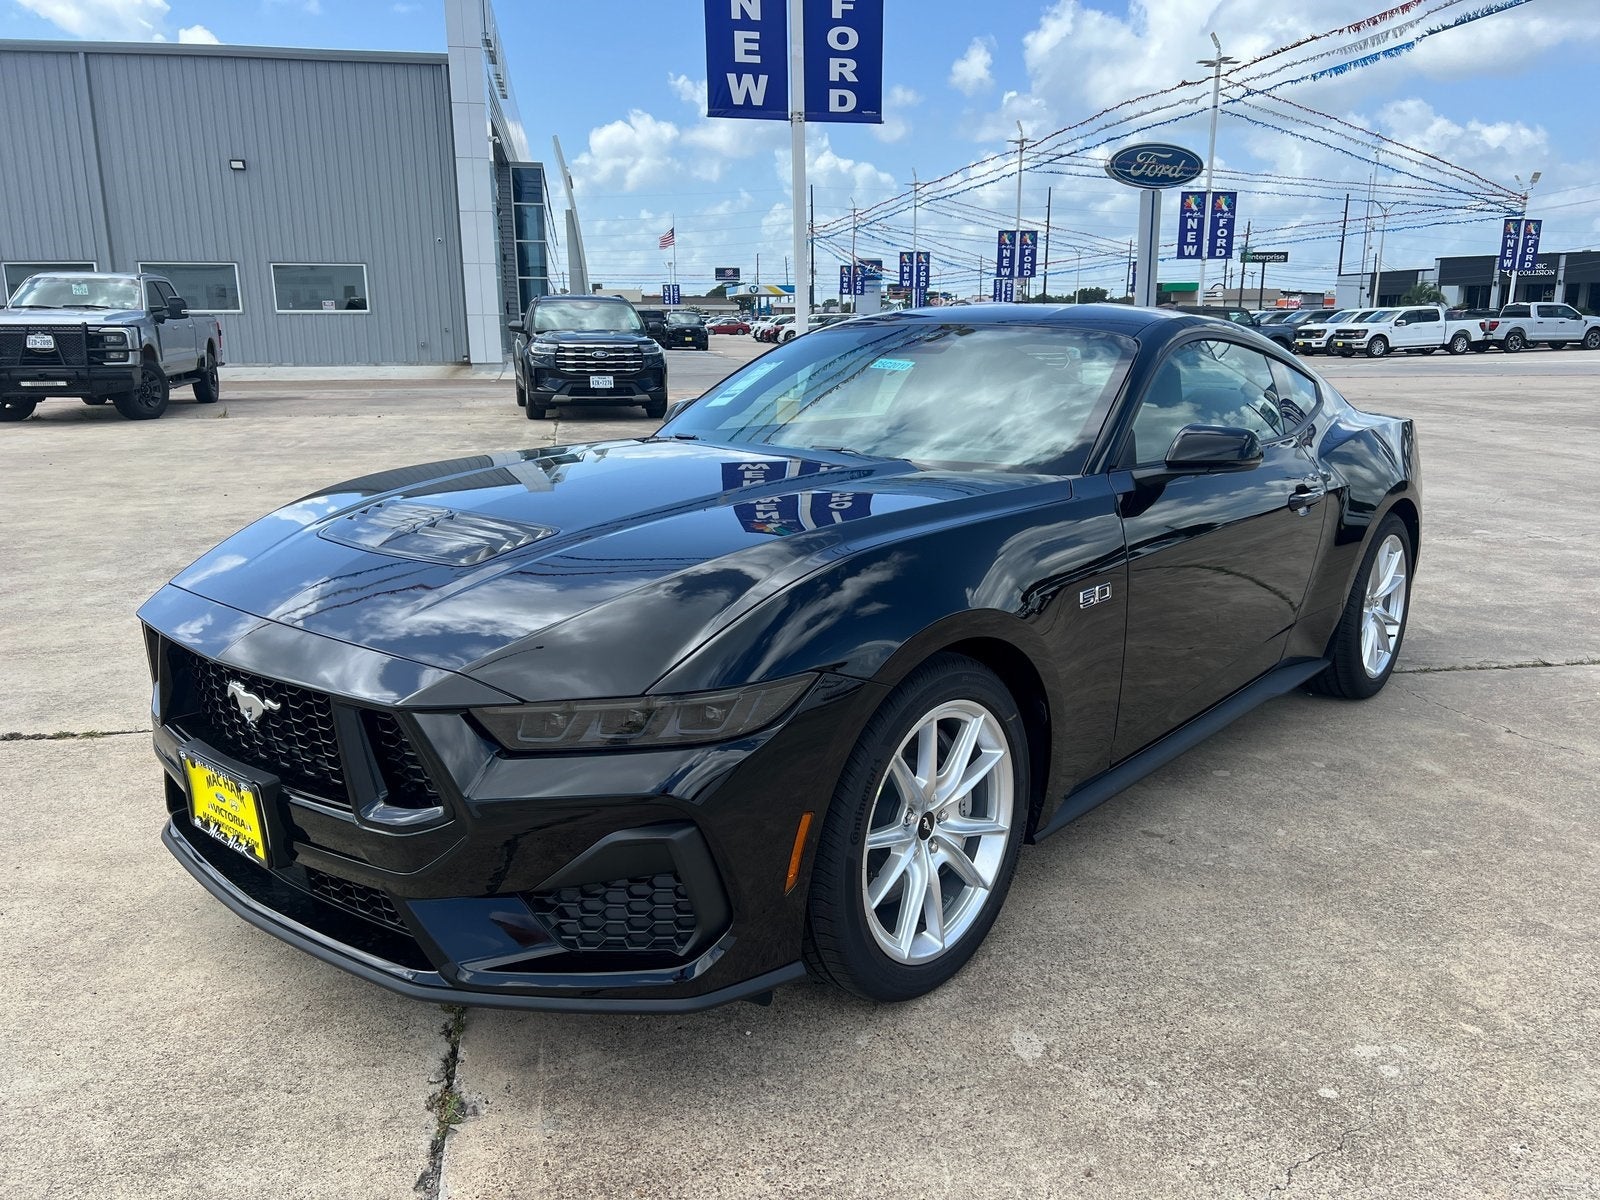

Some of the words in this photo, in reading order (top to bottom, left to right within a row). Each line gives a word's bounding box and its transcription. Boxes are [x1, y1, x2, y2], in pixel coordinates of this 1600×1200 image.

[726, 0, 768, 106] NEW
[827, 0, 859, 113] FORD
[1130, 151, 1185, 178] Ford
[1183, 218, 1197, 256] NEW
[1215, 219, 1228, 257] FORD
[1000, 249, 1010, 276] NEW
[1023, 250, 1032, 276] FORD
[1502, 239, 1514, 268] NEW
[1524, 239, 1535, 268] FORD
[902, 266, 910, 287] NEW
